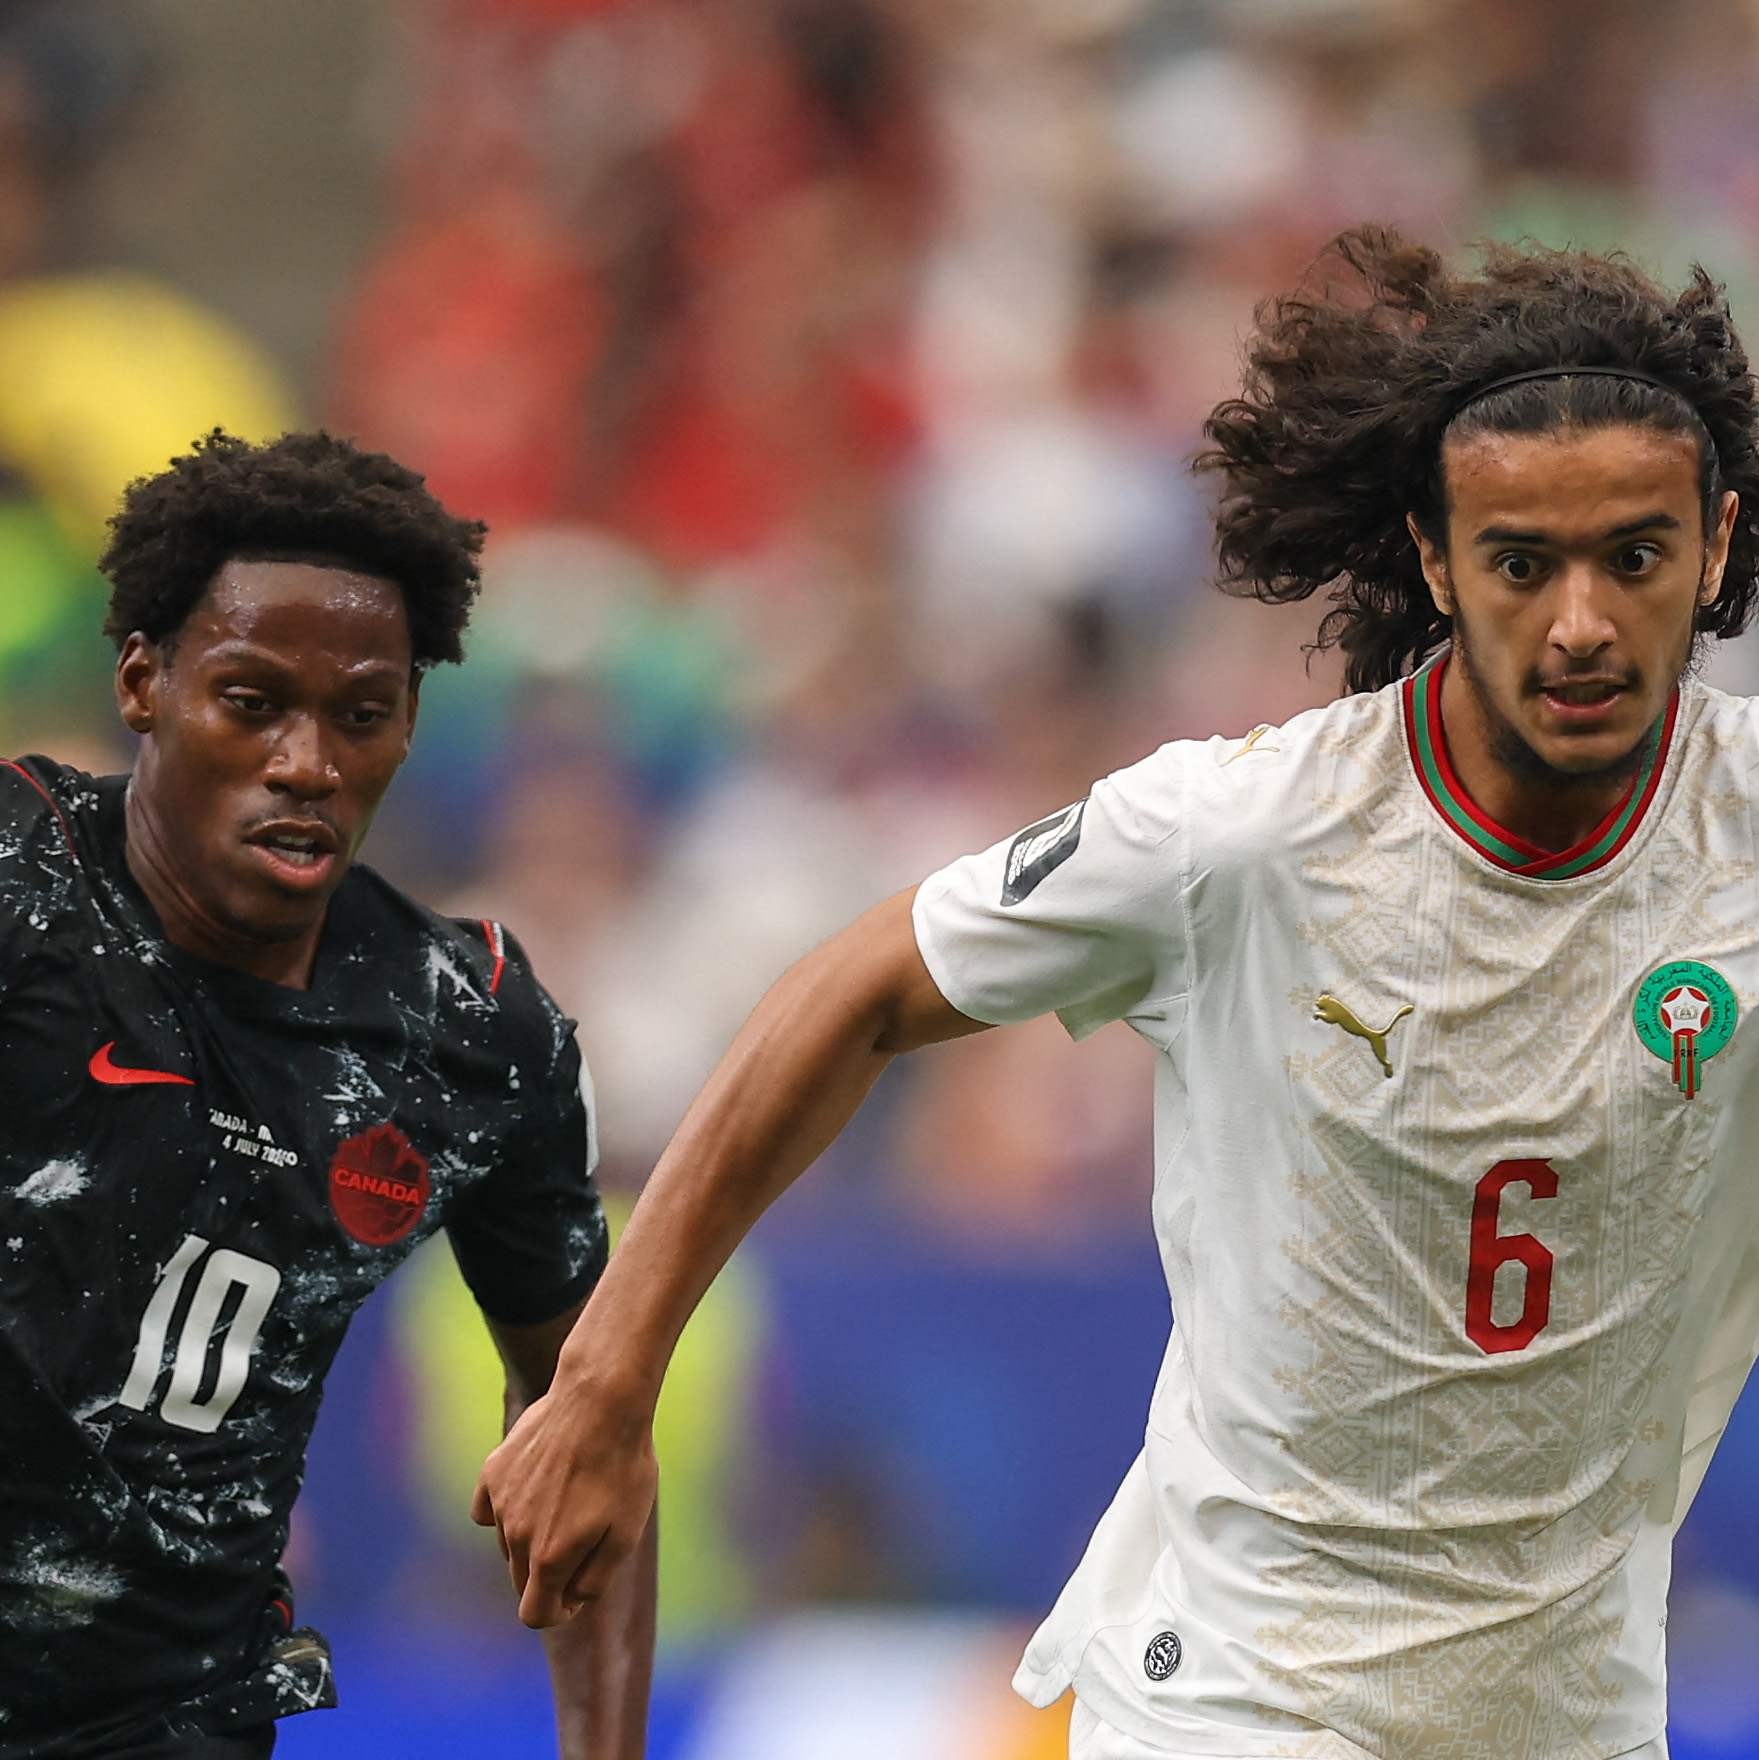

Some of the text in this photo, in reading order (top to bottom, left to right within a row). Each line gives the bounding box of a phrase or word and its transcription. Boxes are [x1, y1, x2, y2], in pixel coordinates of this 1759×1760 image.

[222, 1134, 232, 1150] 4
[233, 1138, 261, 1157] JULY
[334, 1168, 420, 1205] CANADA
[1464, 1157, 1559, 1354] 6
[119, 1233, 281, 1434] 10
